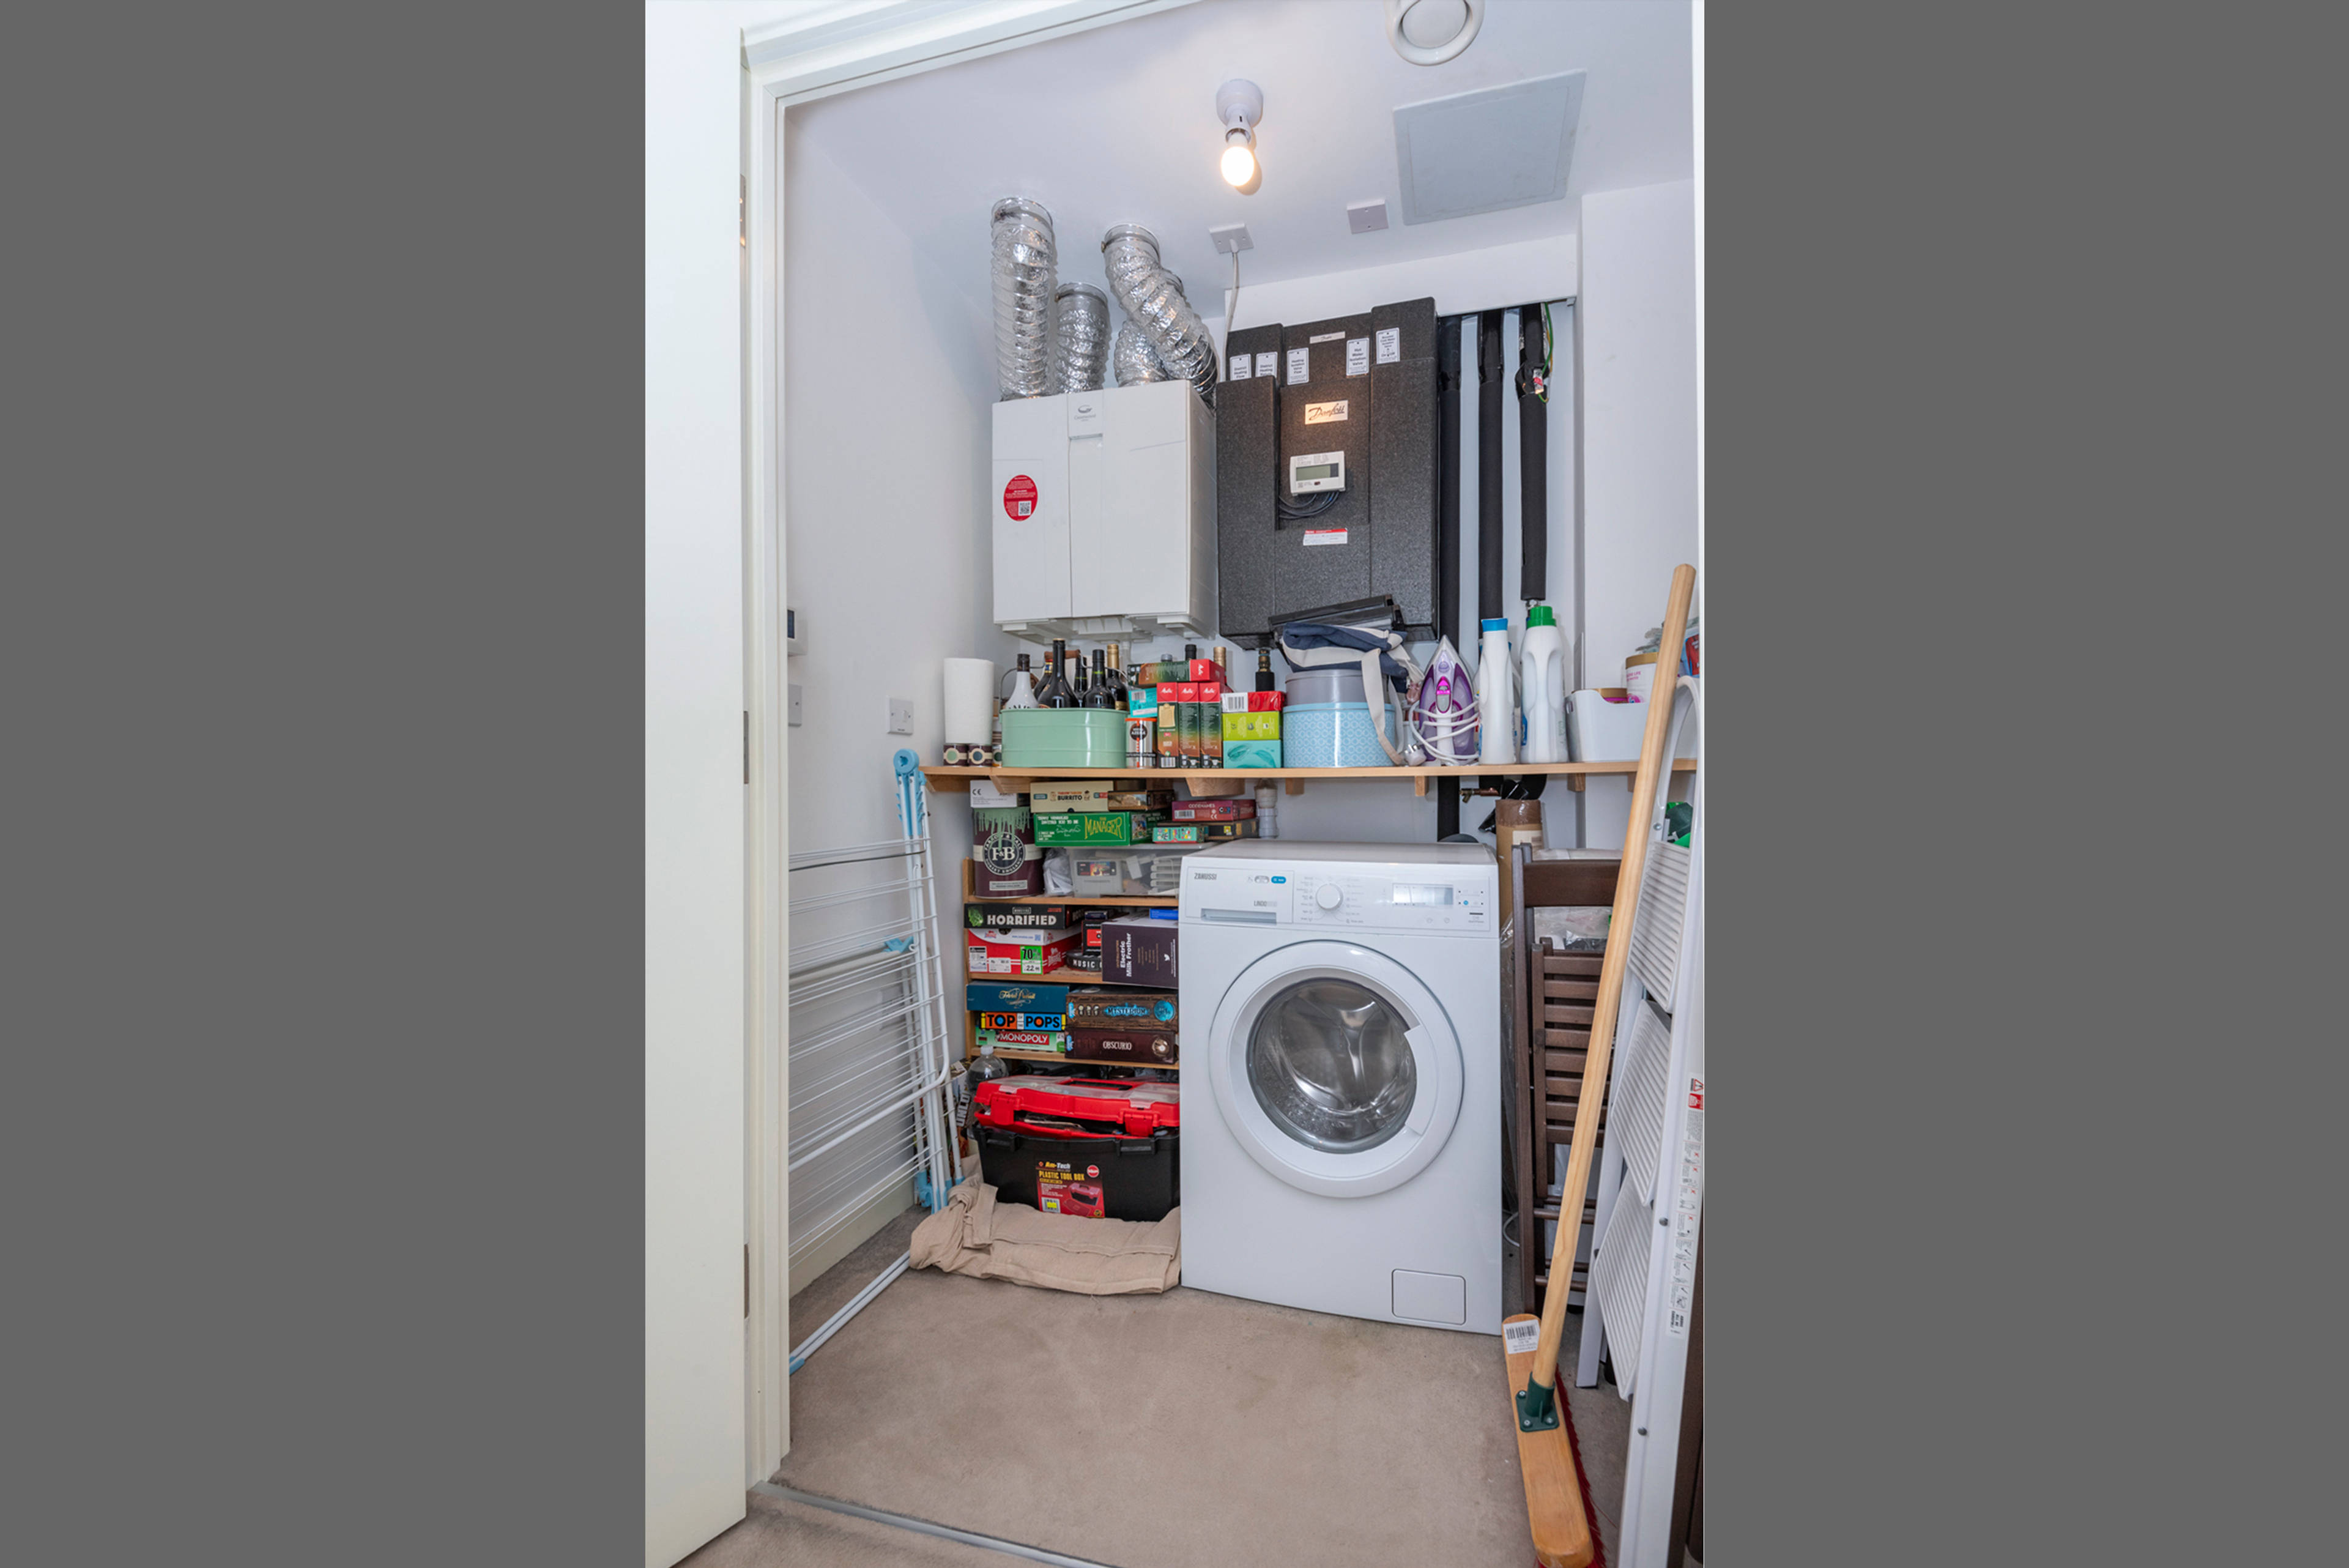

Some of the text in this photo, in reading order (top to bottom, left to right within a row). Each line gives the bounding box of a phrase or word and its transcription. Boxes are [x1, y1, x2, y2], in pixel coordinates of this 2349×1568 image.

[1084, 816, 1123, 840] MANAGER
[987, 915, 1057, 925] HORRIFIED
[1073, 959, 1095, 968] MUSIC
[987, 1014, 1015, 1027] TOP
[1026, 1016, 1060, 1028] POPS
[999, 1032, 1048, 1044] MONOPOLY
[1102, 1041, 1132, 1050] OBSCURIO
[1039, 1170, 1059, 1180] PLASTIC
